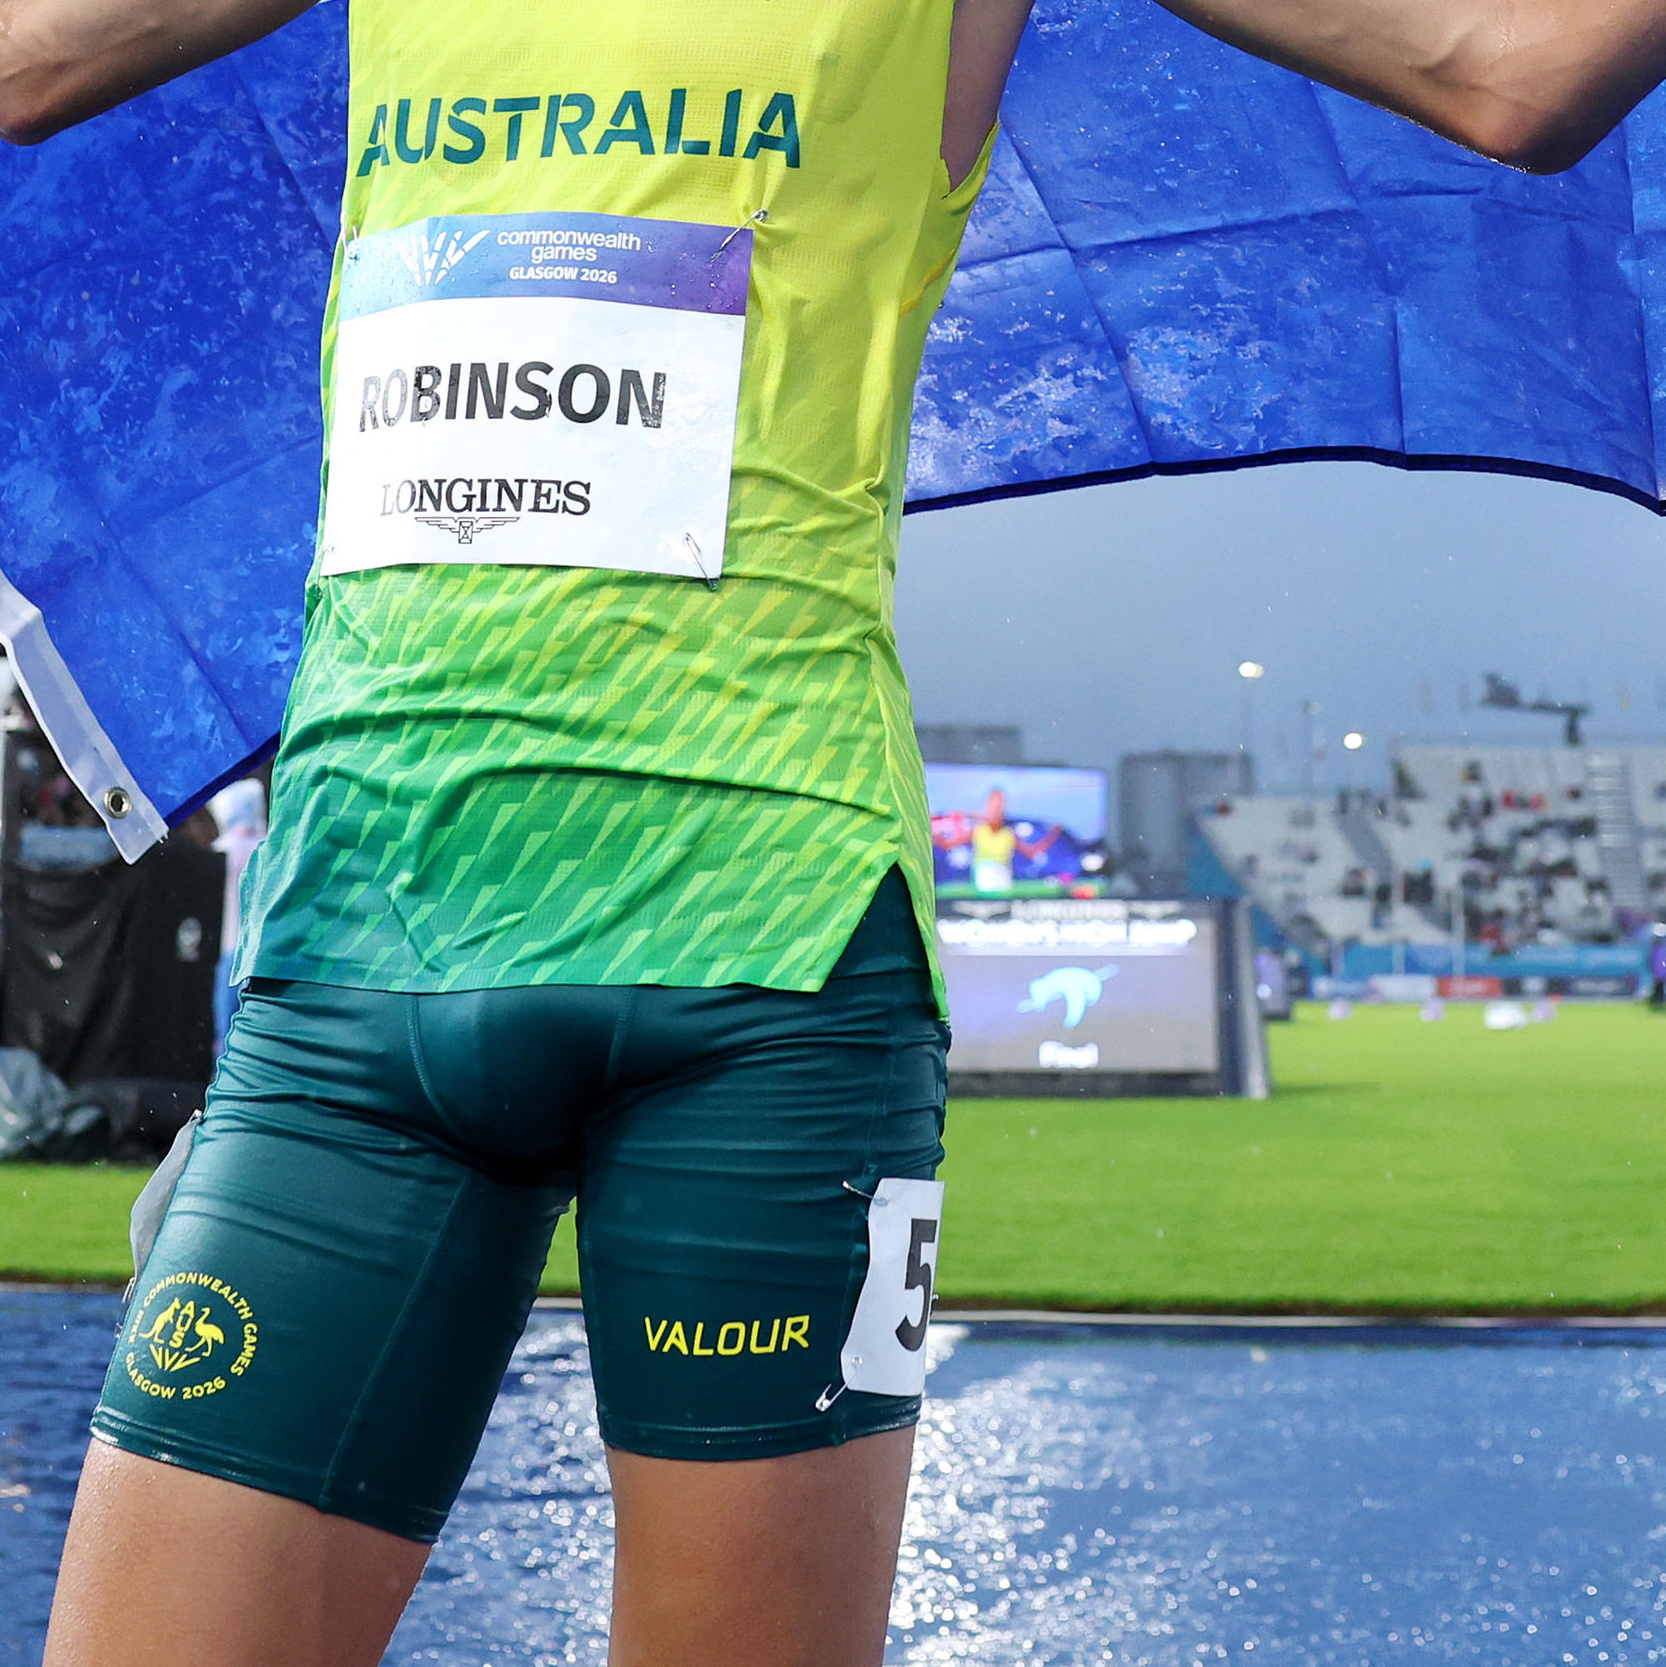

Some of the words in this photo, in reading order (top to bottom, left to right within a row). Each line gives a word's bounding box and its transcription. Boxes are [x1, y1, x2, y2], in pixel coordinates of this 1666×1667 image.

[356, 88, 801, 178] AUSTRALIA
[497, 230, 642, 251] commonwealth
[530, 244, 598, 264] games
[509, 266, 579, 282] GLASGOW
[580, 267, 618, 284] 2026
[359, 361, 667, 433] ROBINSON
[380, 477, 592, 516] LONGINES
[895, 1218, 938, 1352] 5
[143, 1272, 253, 1320] COMMONWEALTH
[230, 1322, 258, 1376] GAMES
[644, 1314, 811, 1356] VALOUR
[126, 1351, 176, 1400] GLASGOW
[182, 1376, 227, 1400] 2026
